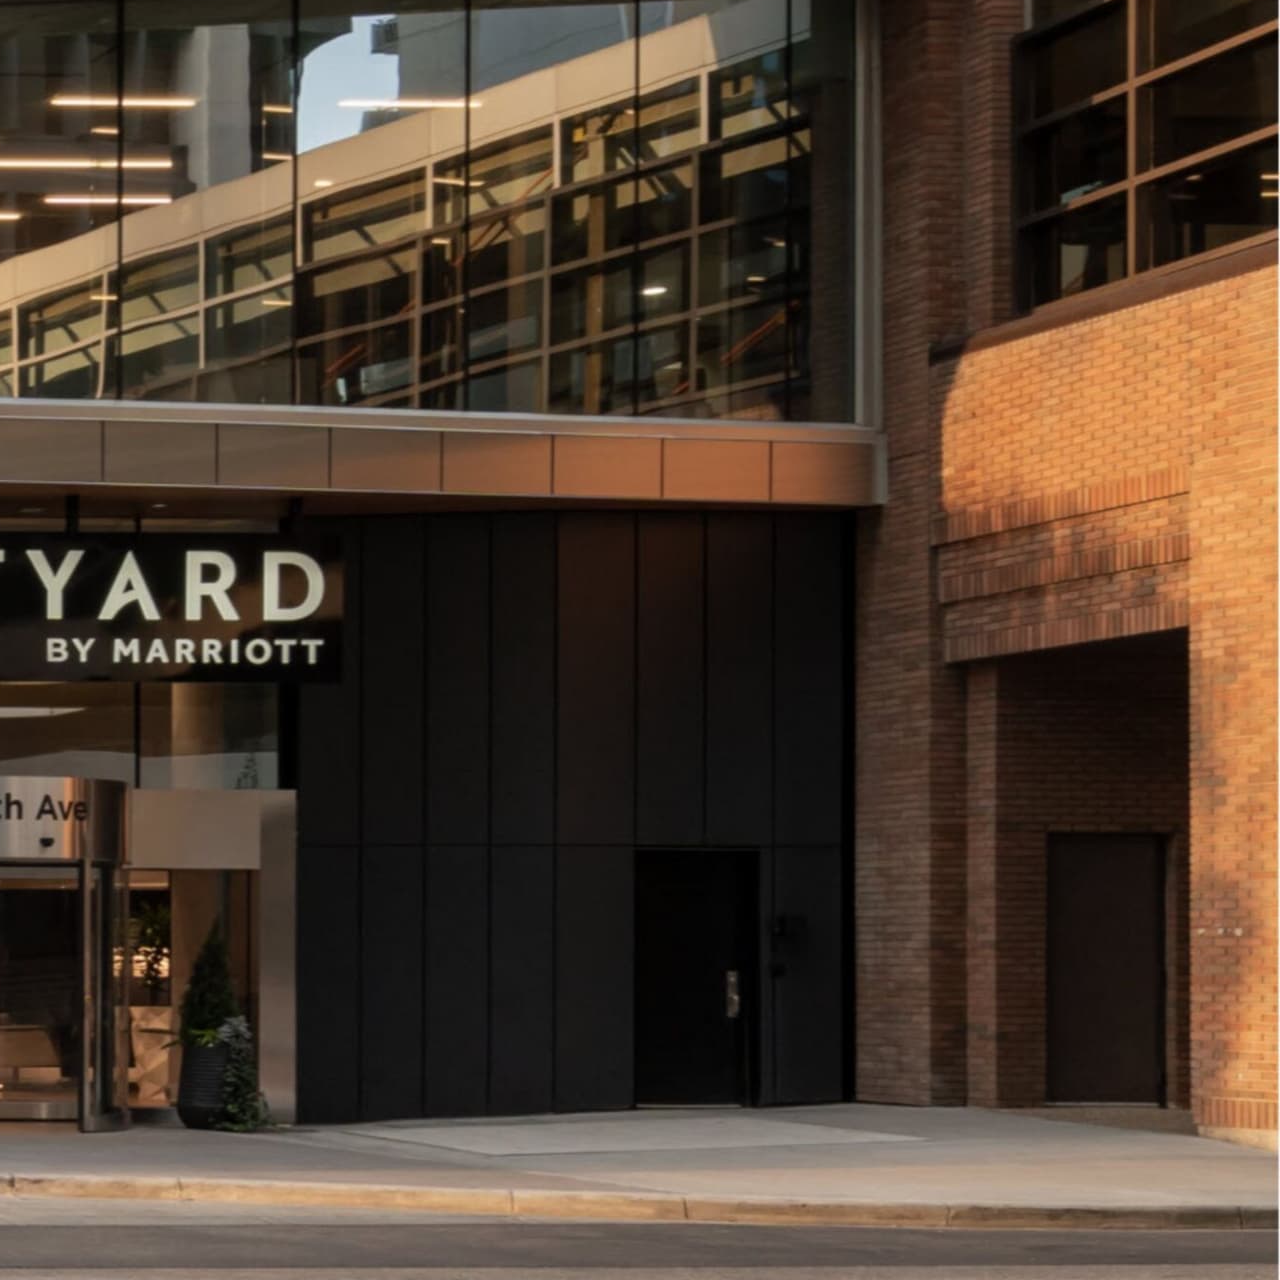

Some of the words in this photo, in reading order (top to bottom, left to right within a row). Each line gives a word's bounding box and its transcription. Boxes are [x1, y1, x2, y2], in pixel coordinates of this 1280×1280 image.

[46, 637, 95, 663] BY
[113, 638, 325, 665] MARRIOTT
[36, 794, 89, 821] Ave
